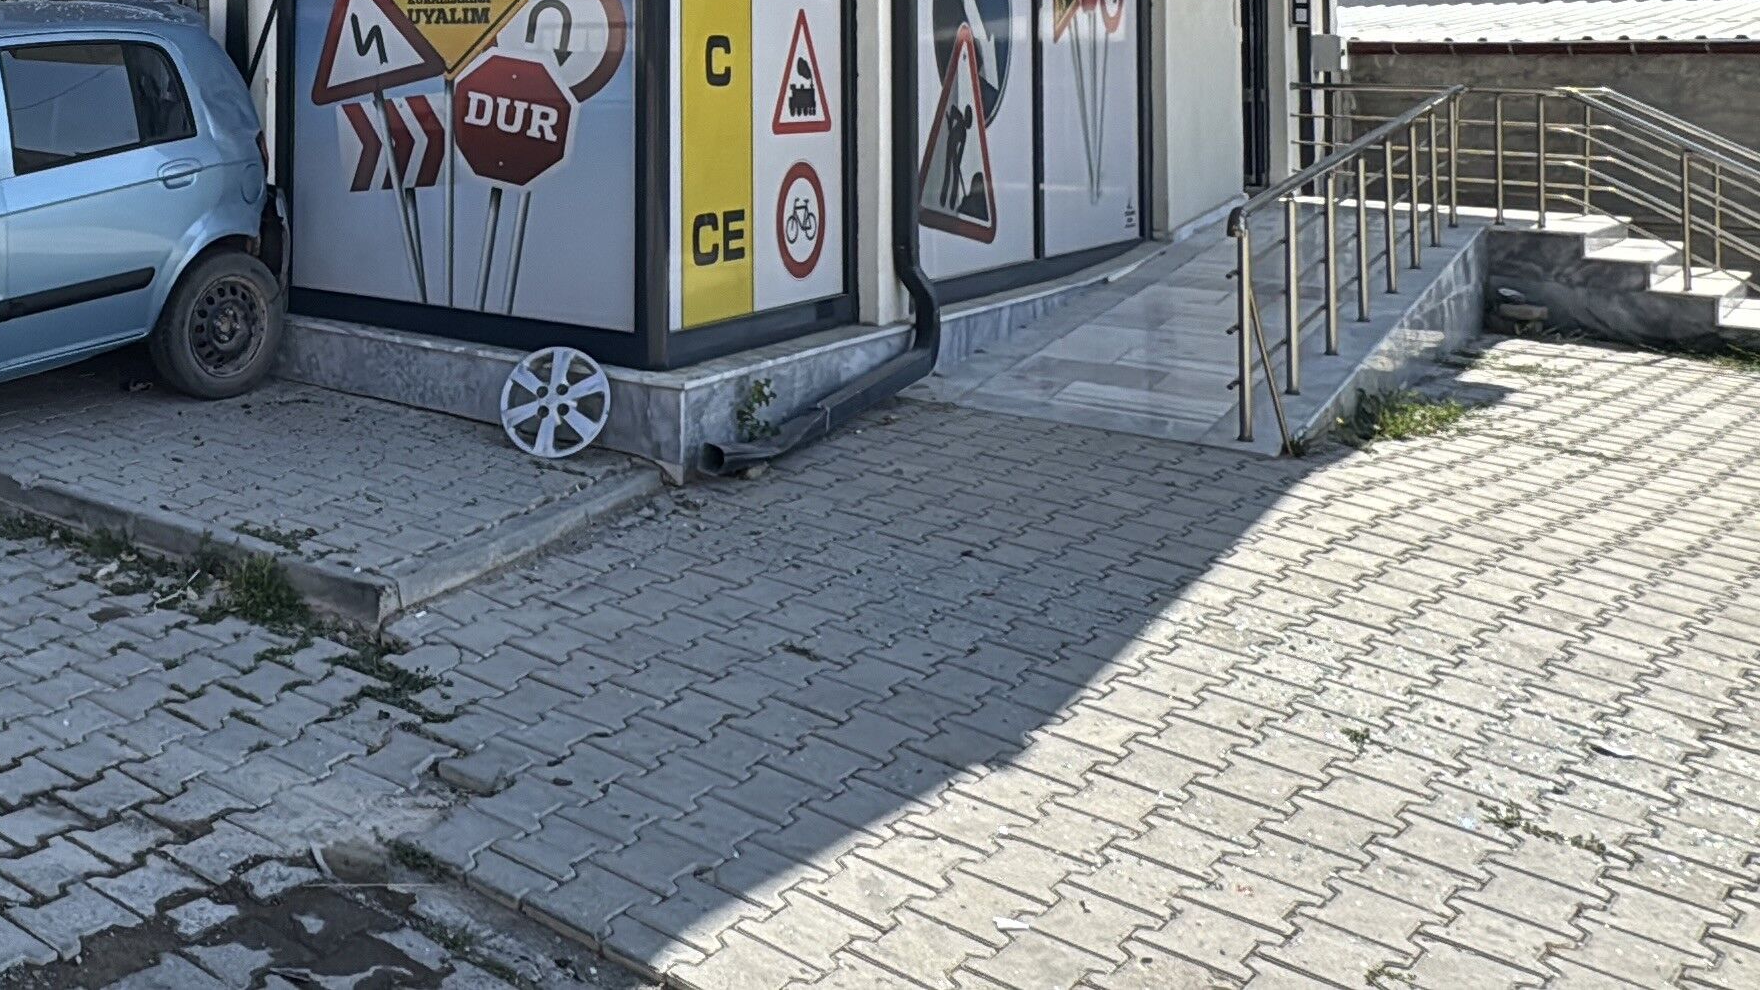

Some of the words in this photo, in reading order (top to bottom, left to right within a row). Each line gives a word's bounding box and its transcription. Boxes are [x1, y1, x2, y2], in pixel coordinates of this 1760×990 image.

[408, 7, 491, 25] UYALIM
[705, 34, 732, 88] C
[464, 91, 560, 143] DUR
[692, 209, 746, 268] CE
